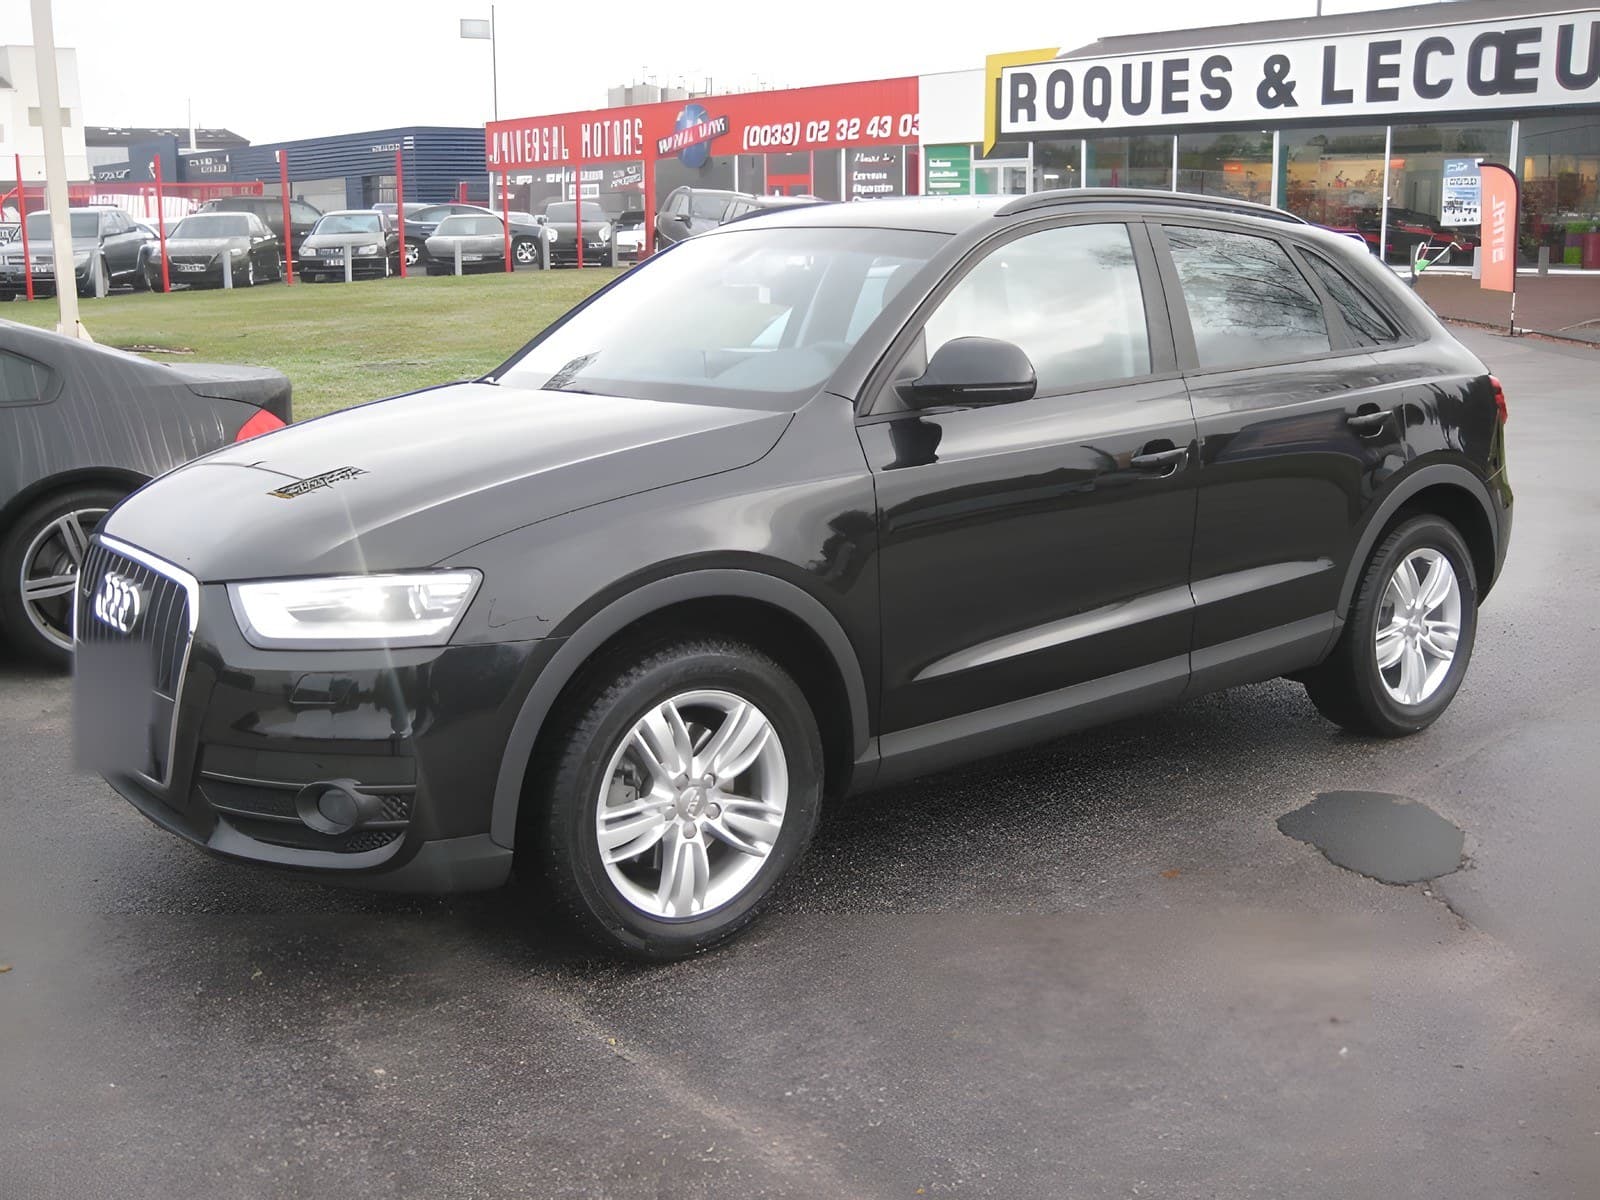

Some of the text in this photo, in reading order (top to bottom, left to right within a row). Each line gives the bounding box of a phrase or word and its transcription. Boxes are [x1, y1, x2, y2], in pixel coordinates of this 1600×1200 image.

[1009, 54, 1233, 123] ROQUES
[1256, 53, 1299, 110] &
[581, 118, 643, 159] MOTORS
[743, 121, 801, 150] (0033)
[806, 120, 830, 143] 02
[836, 117, 861, 141] 32
[866, 115, 892, 139] 43
